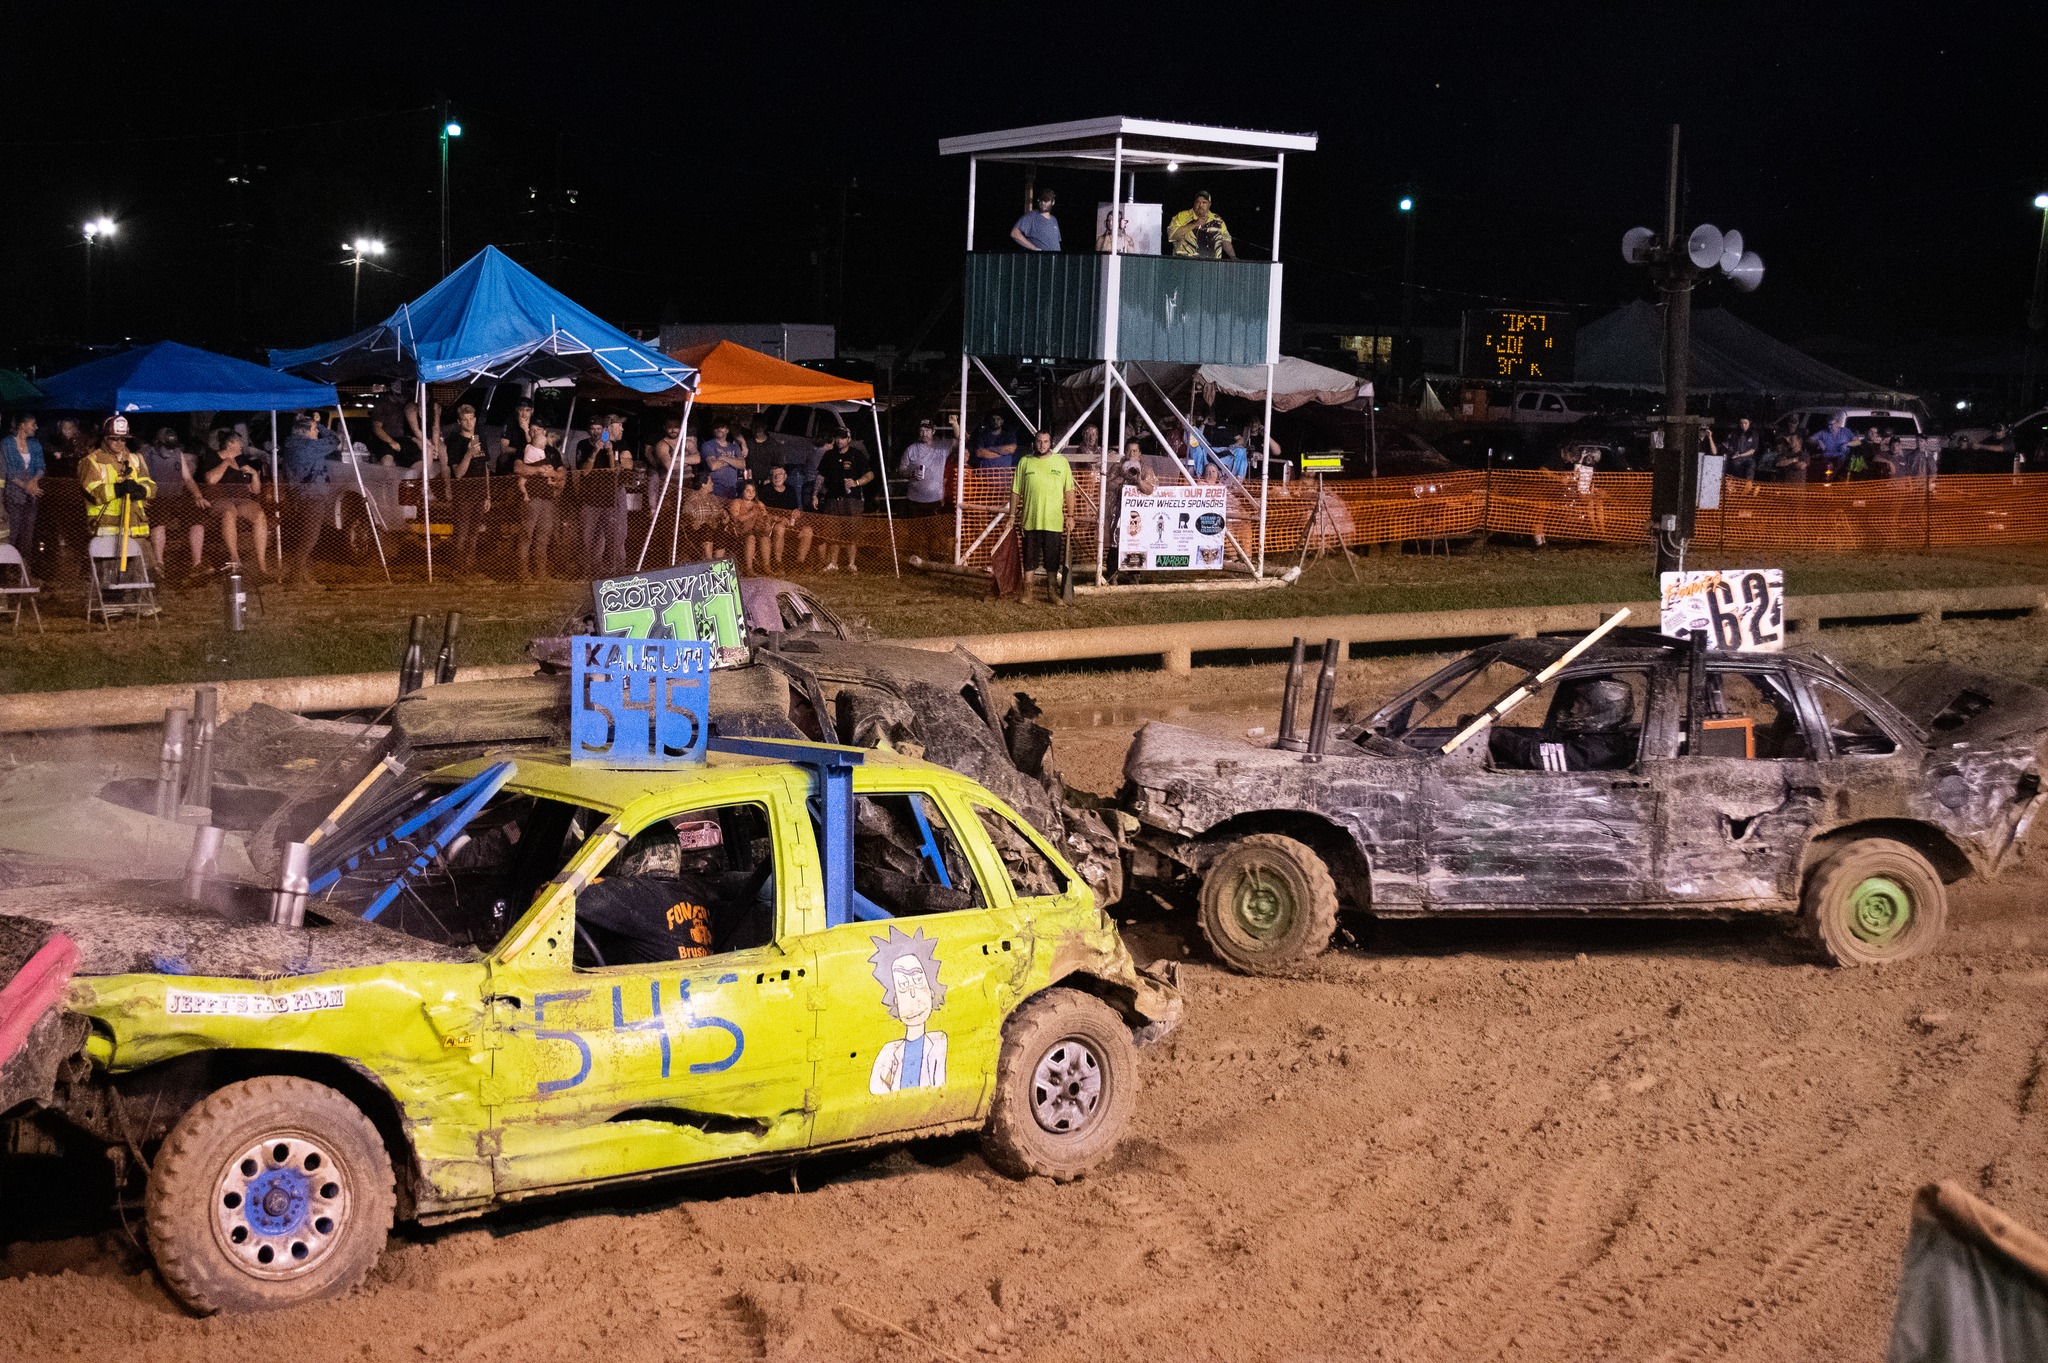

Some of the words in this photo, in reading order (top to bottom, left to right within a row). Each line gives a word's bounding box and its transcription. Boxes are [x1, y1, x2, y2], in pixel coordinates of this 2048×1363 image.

[1125, 499, 1154, 508] POWER
[1157, 499, 1186, 508] WHEELS
[1187, 499, 1224, 508] SPONSORS
[1206, 488, 1226, 498] 2021
[601, 570, 731, 613] CORWIN
[1707, 573, 1778, 650] 62
[603, 593, 741, 648] 711
[581, 673, 701, 757] 545
[292, 989, 344, 1012] FARM
[534, 973, 745, 1094] 545
